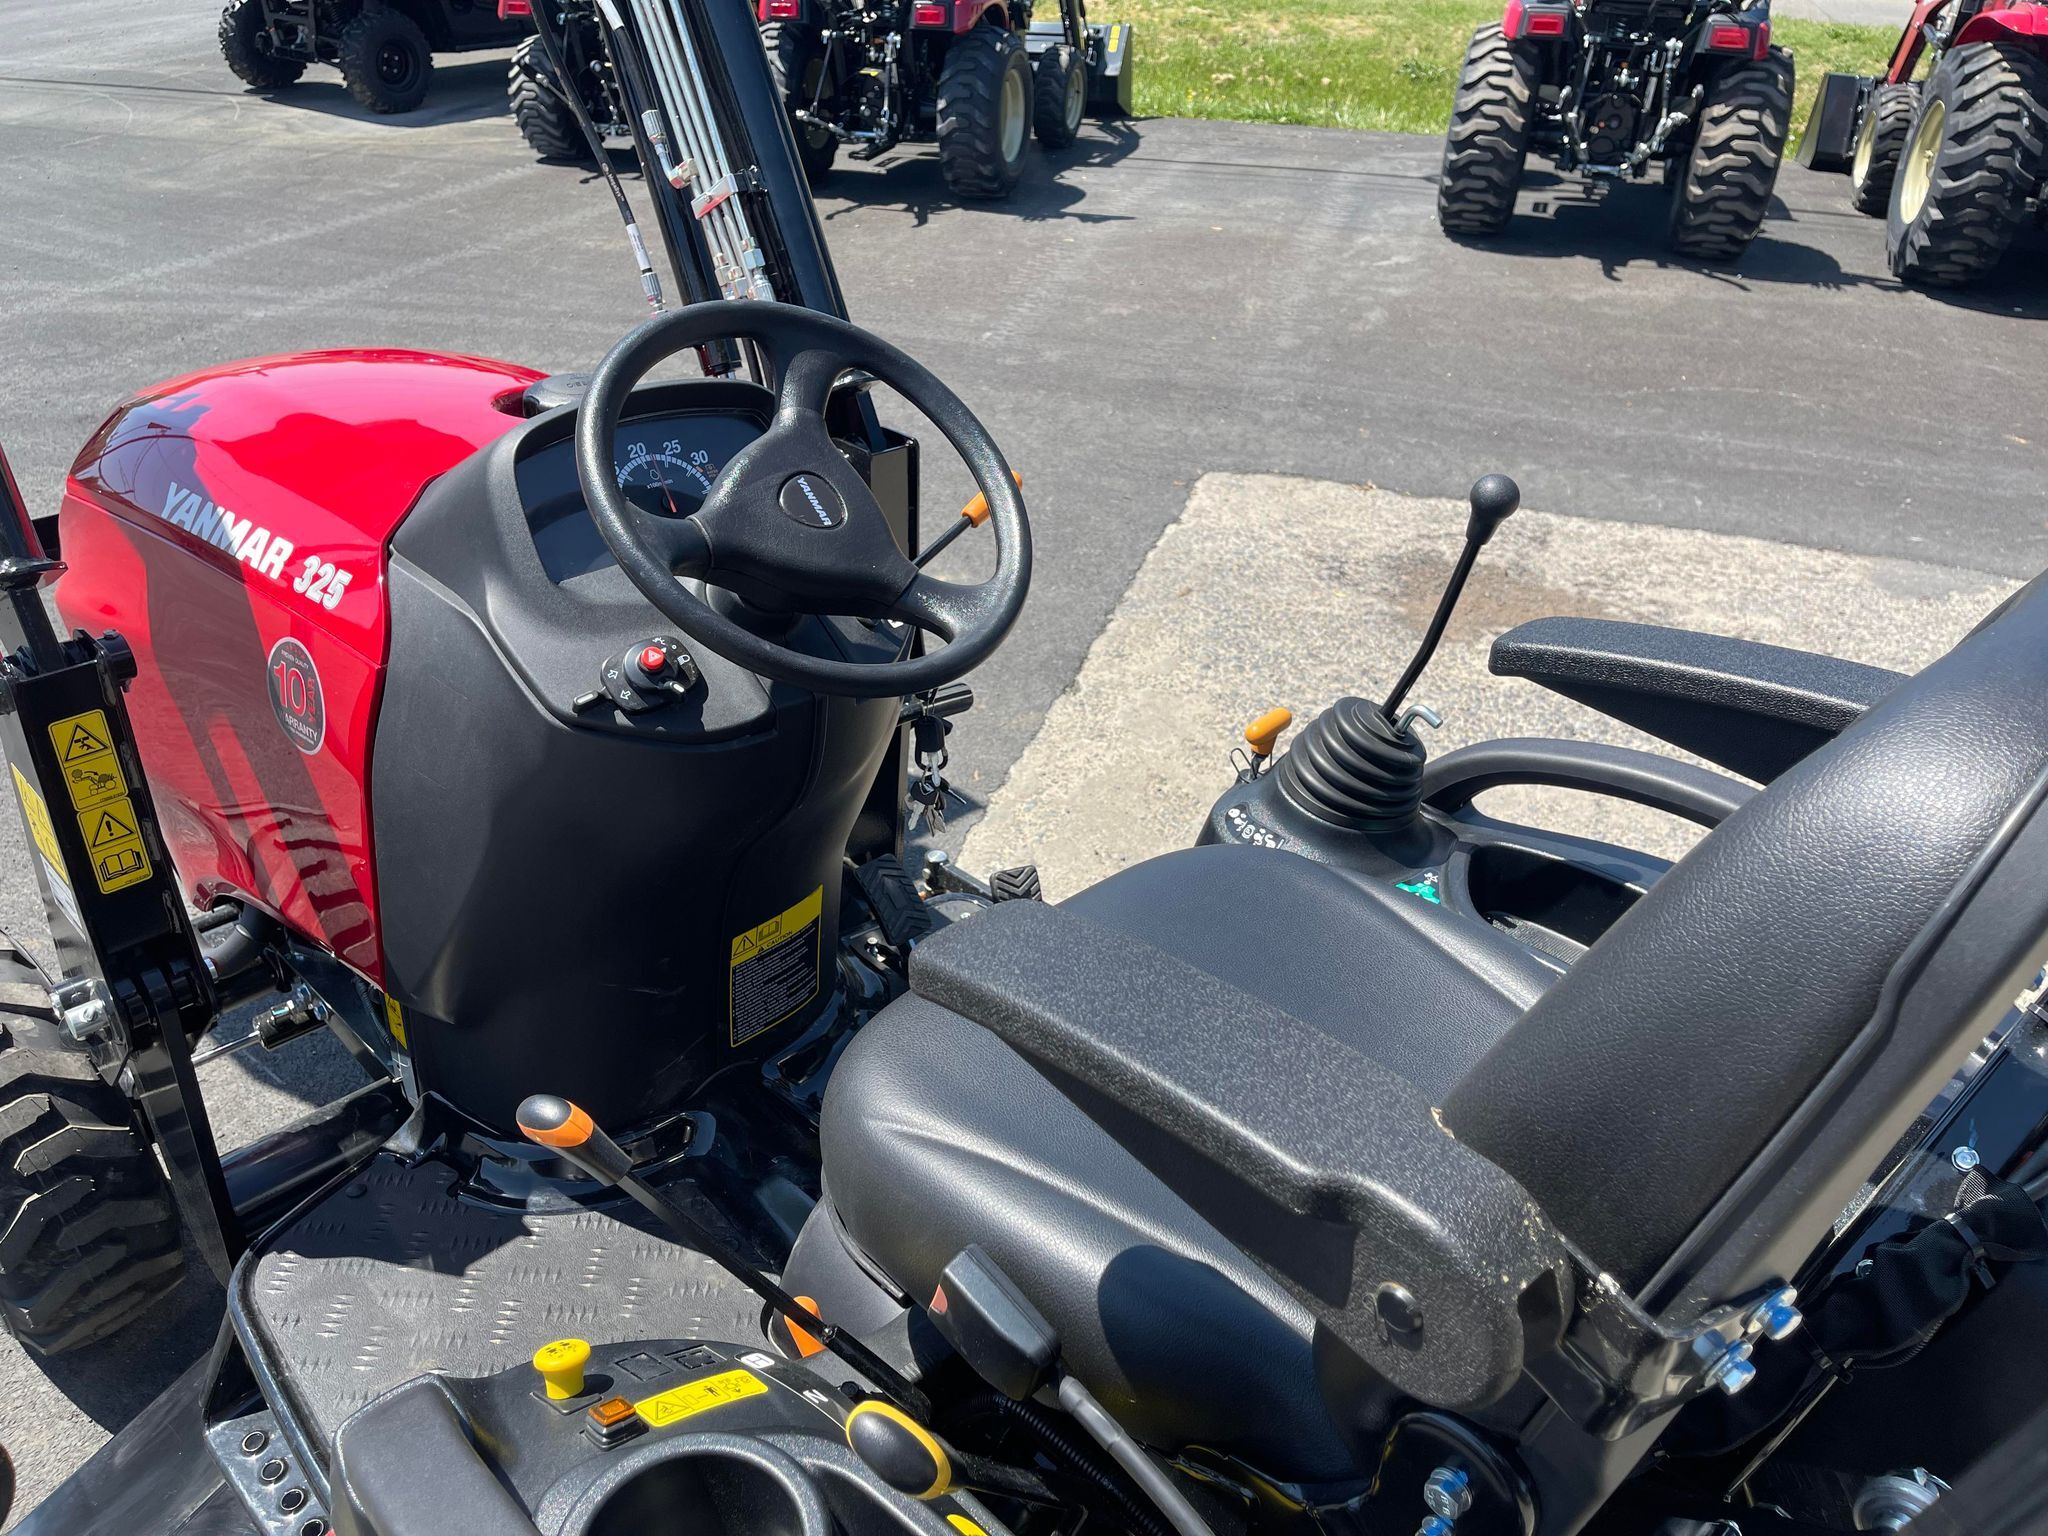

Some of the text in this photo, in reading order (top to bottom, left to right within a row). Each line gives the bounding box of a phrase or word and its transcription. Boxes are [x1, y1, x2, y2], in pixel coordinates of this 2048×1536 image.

[627, 442, 647, 459] 20
[663, 439, 681, 455] 25
[690, 450, 709, 466] 30
[797, 476, 832, 526] YANMAR
[161, 481, 353, 610] YANMAR 325
[273, 660, 307, 717] 10
[307, 676, 316, 724] YEAR
[280, 709, 318, 742] ARRANTY
[766, 930, 793, 948] CAUTION
[746, 1355, 771, 1367] H
[802, 1388, 829, 1404] N
